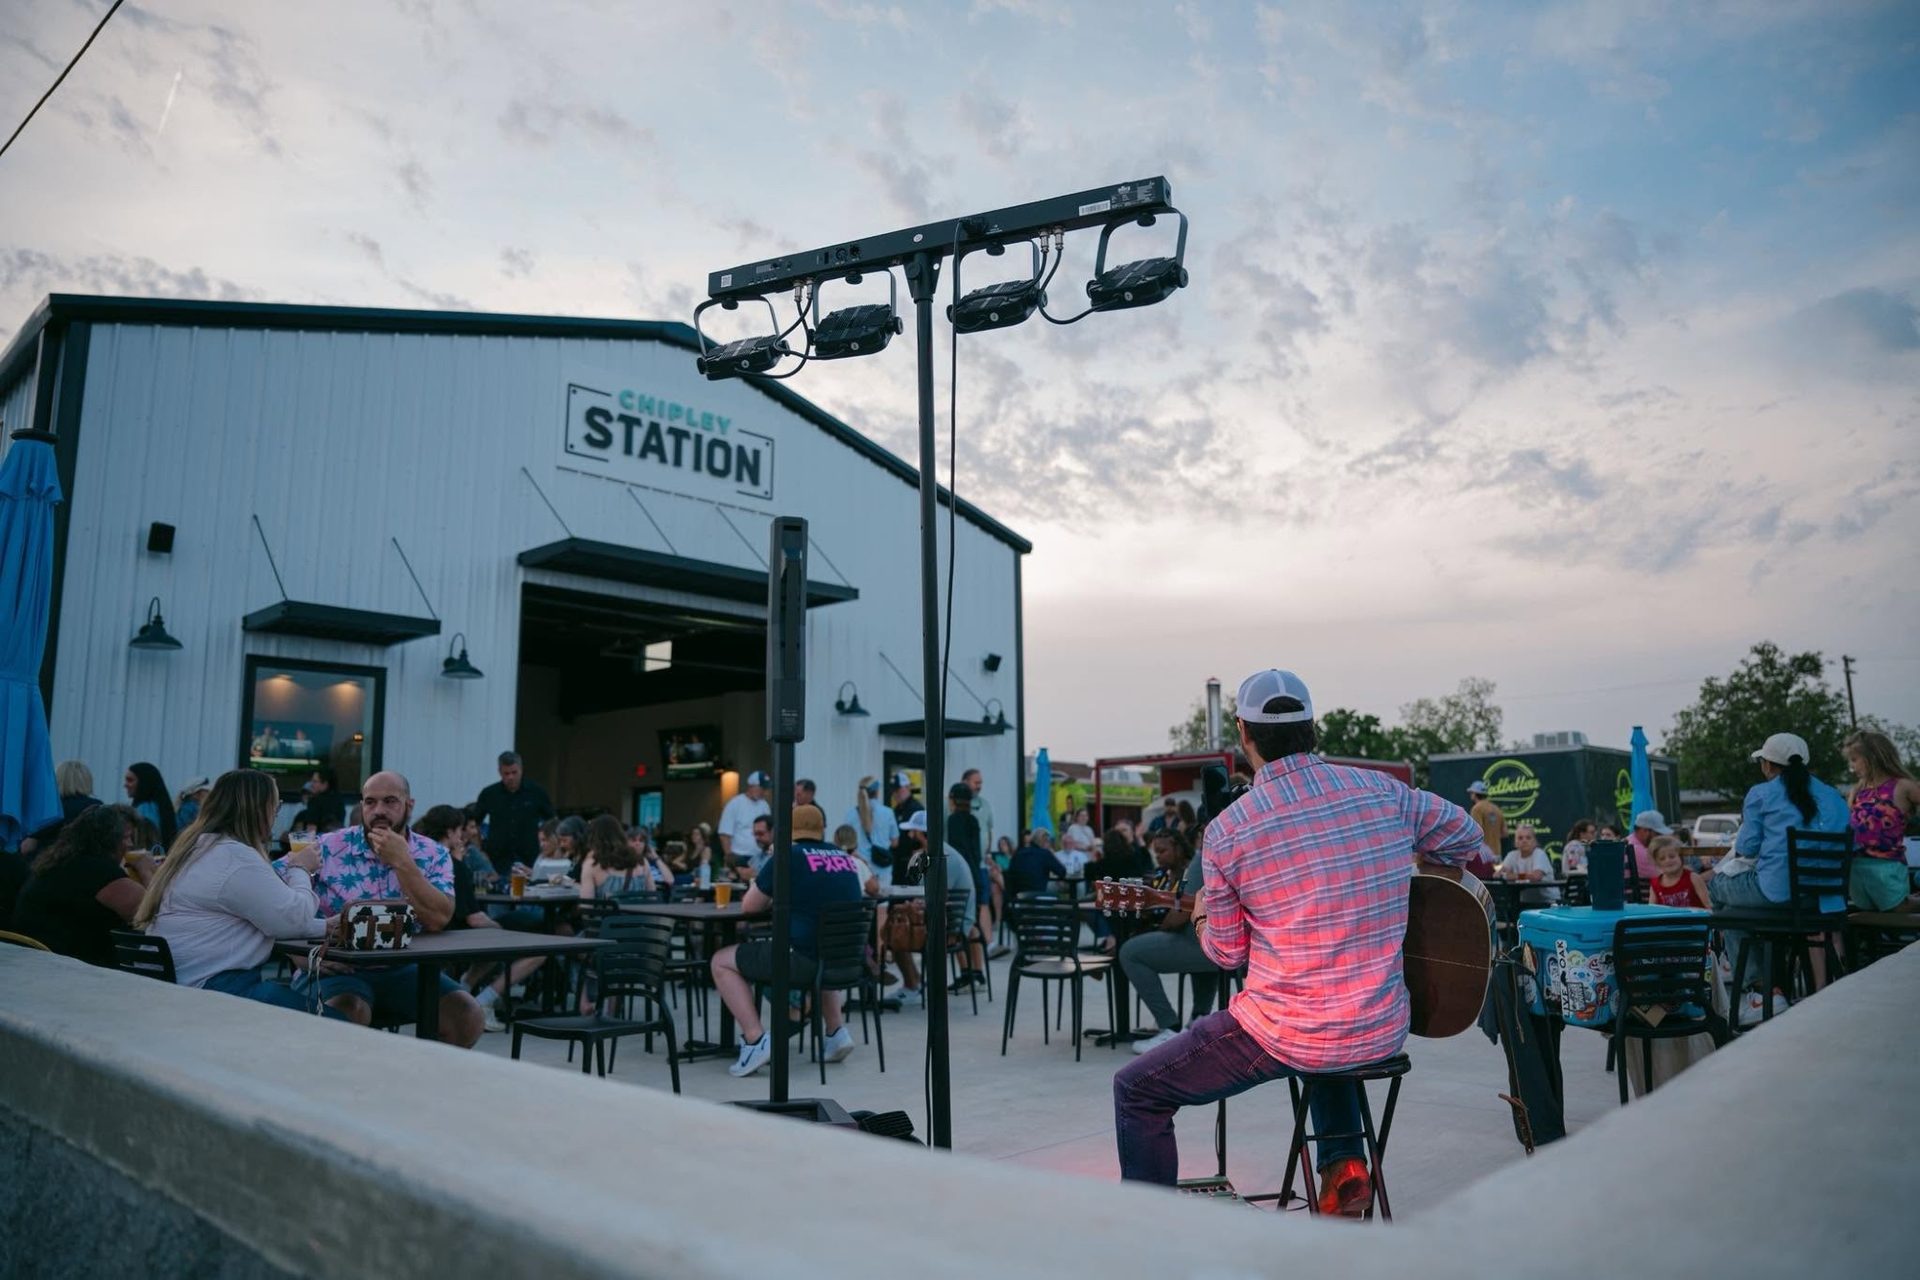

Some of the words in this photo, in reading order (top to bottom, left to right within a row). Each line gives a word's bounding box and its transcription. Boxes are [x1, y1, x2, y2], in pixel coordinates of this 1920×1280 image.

[618, 389, 732, 435] CHIPLEY
[583, 406, 761, 487] STATION
[1556, 940, 1567, 969] OAK
